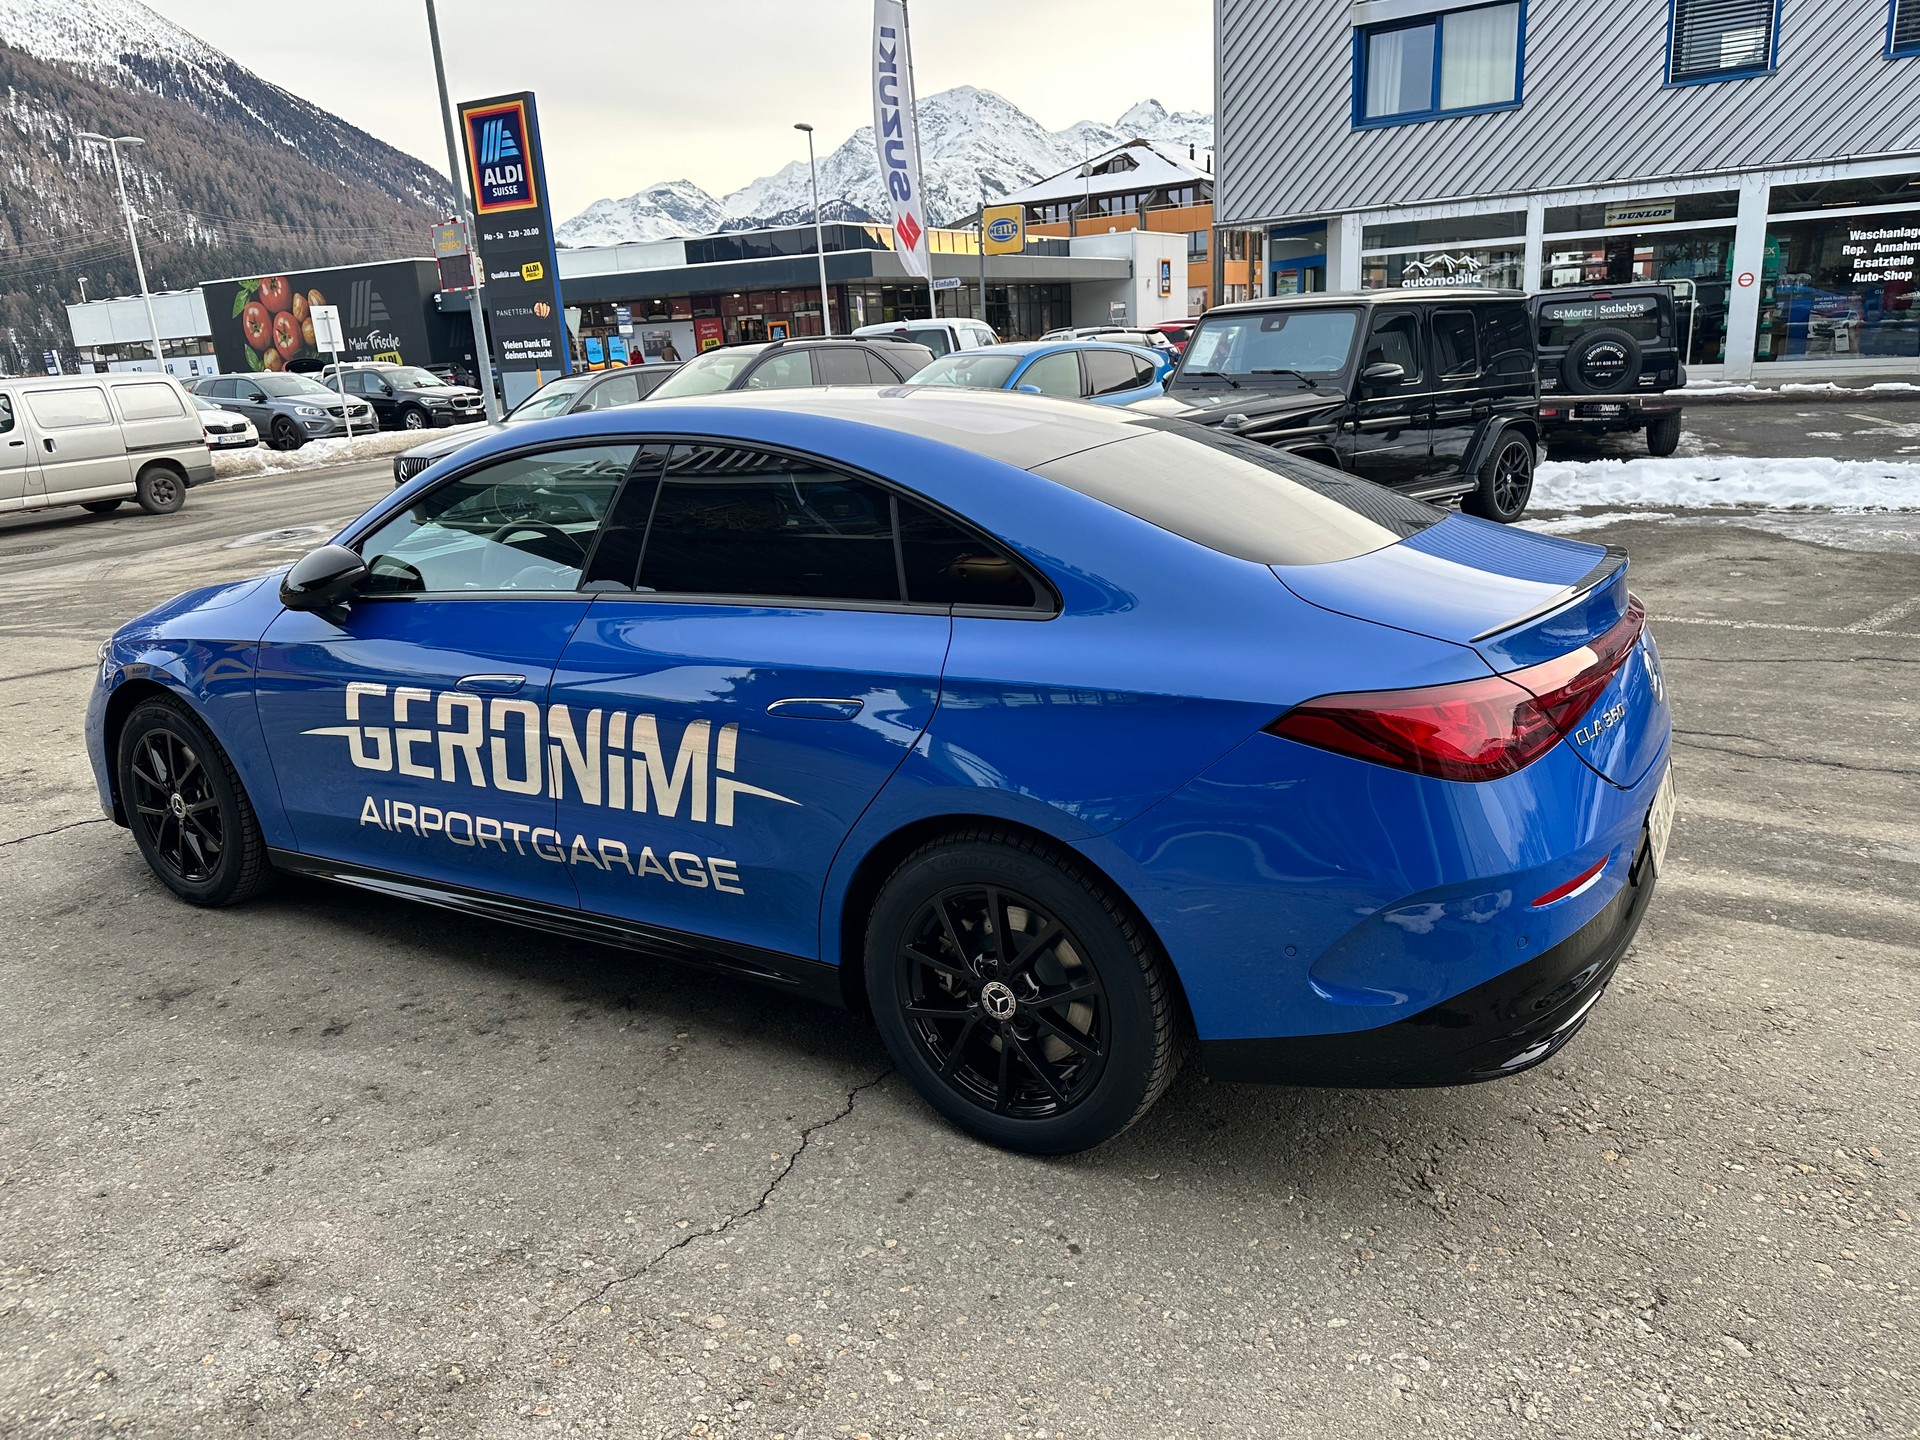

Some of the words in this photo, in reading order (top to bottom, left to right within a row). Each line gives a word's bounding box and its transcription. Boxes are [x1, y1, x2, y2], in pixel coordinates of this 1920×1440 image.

[484, 163, 524, 187] ALDI
[492, 185, 518, 197] SUISSE
[1617, 209, 1672, 220] DUNLOP
[442, 229, 454, 240] IHR
[523, 228, 539, 236] 20.00
[990, 223, 1018, 235] HELLA
[438, 240, 461, 251] TEMPO
[1842, 245, 1867, 256] Rep.
[1853, 256, 1915, 269] Ersatzteile
[525, 265, 540, 274] ALDI
[1402, 273, 1481, 288] automobile
[1852, 270, 1913, 283] Auto-Shop
[935, 279, 959, 288] Einfahrt
[496, 309, 533, 317] PANETTERIA
[1553, 308, 1592, 319] St.Moritz
[1600, 303, 1644, 314] Sotheby's
[348, 337, 368, 350] Mehr
[366, 329, 400, 350] Frische
[503, 340, 523, 350] Vielen
[524, 338, 541, 349] Dank
[541, 338, 551, 348] für
[505, 350, 527, 359] deinen
[1580, 404, 1624, 412] GERONIMI
[1574, 719, 1603, 746] CLA
[300, 681, 803, 827] GERONIMI
[360, 795, 745, 895] AIRPORTGARAGE
